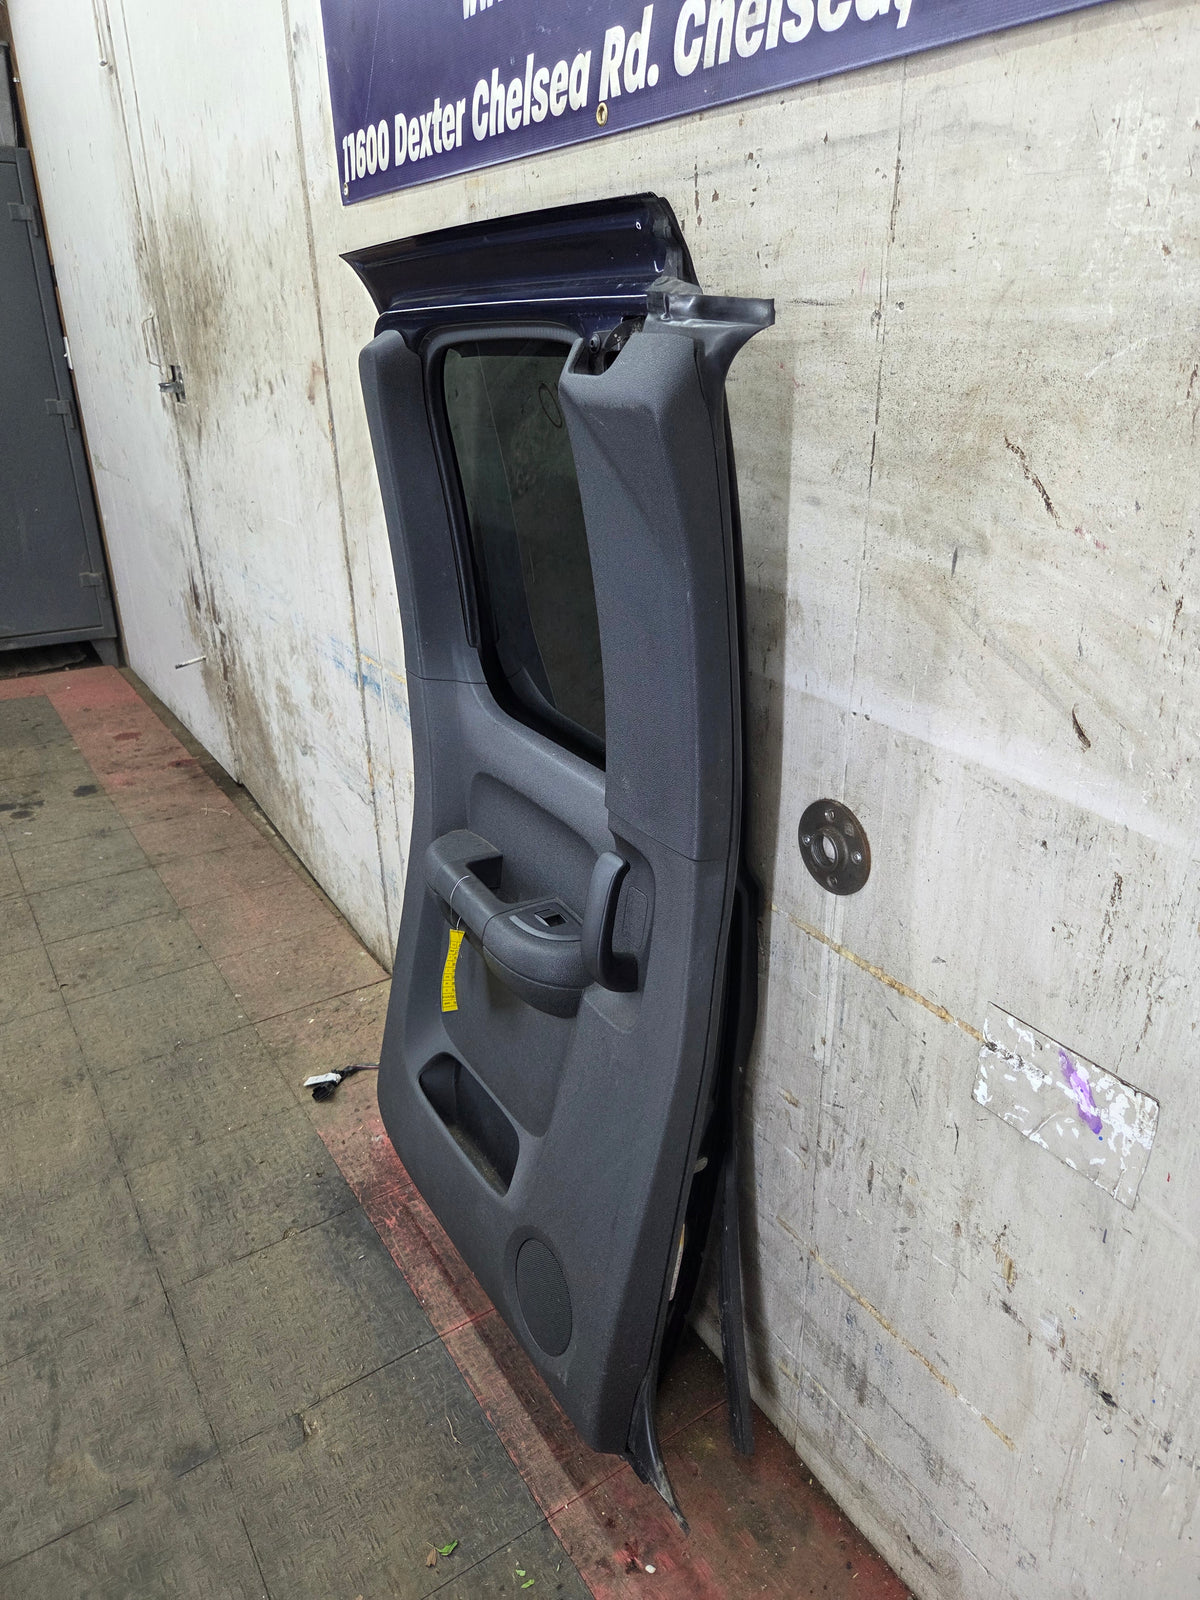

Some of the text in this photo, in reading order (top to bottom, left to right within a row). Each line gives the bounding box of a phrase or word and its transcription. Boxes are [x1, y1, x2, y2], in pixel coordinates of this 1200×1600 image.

[342, 119, 390, 184] 11600
[394, 97, 466, 168] Dexter
[472, 50, 592, 142] Chelsea
[598, 3, 660, 103] Rd.
